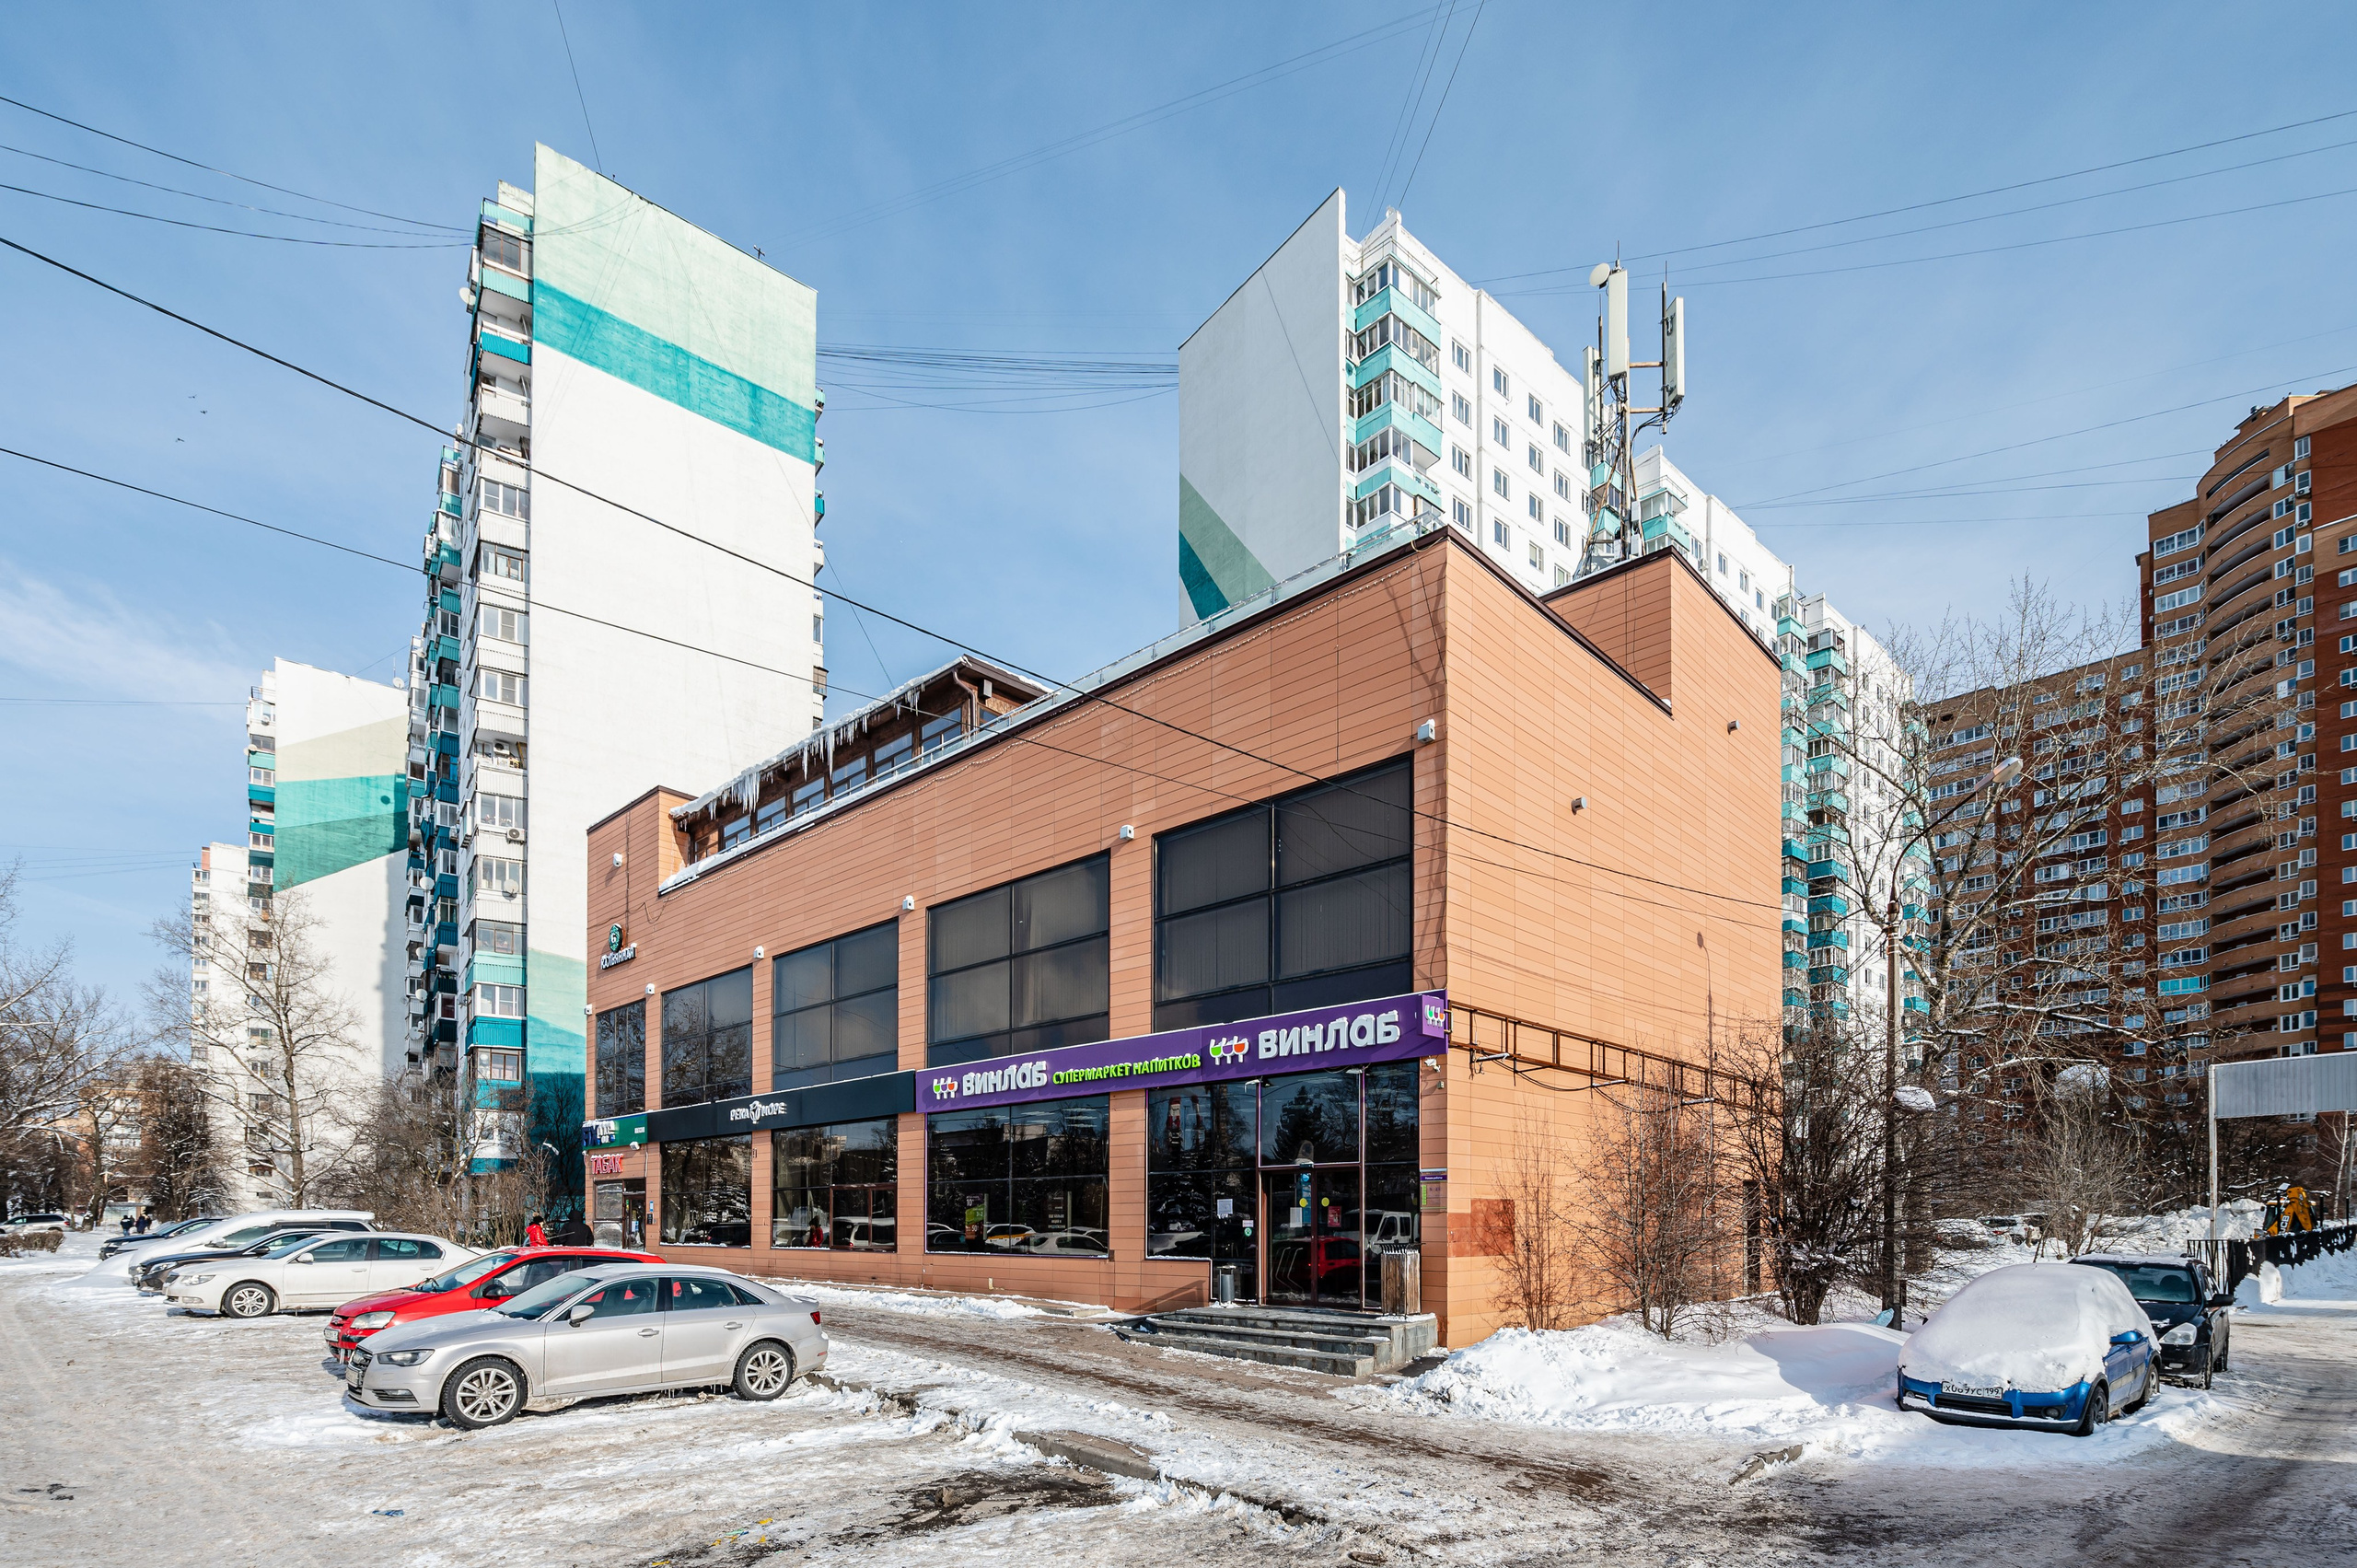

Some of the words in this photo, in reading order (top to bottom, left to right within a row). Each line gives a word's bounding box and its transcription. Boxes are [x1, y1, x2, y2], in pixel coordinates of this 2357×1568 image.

[1052, 1063, 1132, 1085] СУПЕРМАРКЕТ
[1132, 1053, 1201, 1075] НАПИТКОВ
[590, 1154, 623, 1175] ТАБАК
